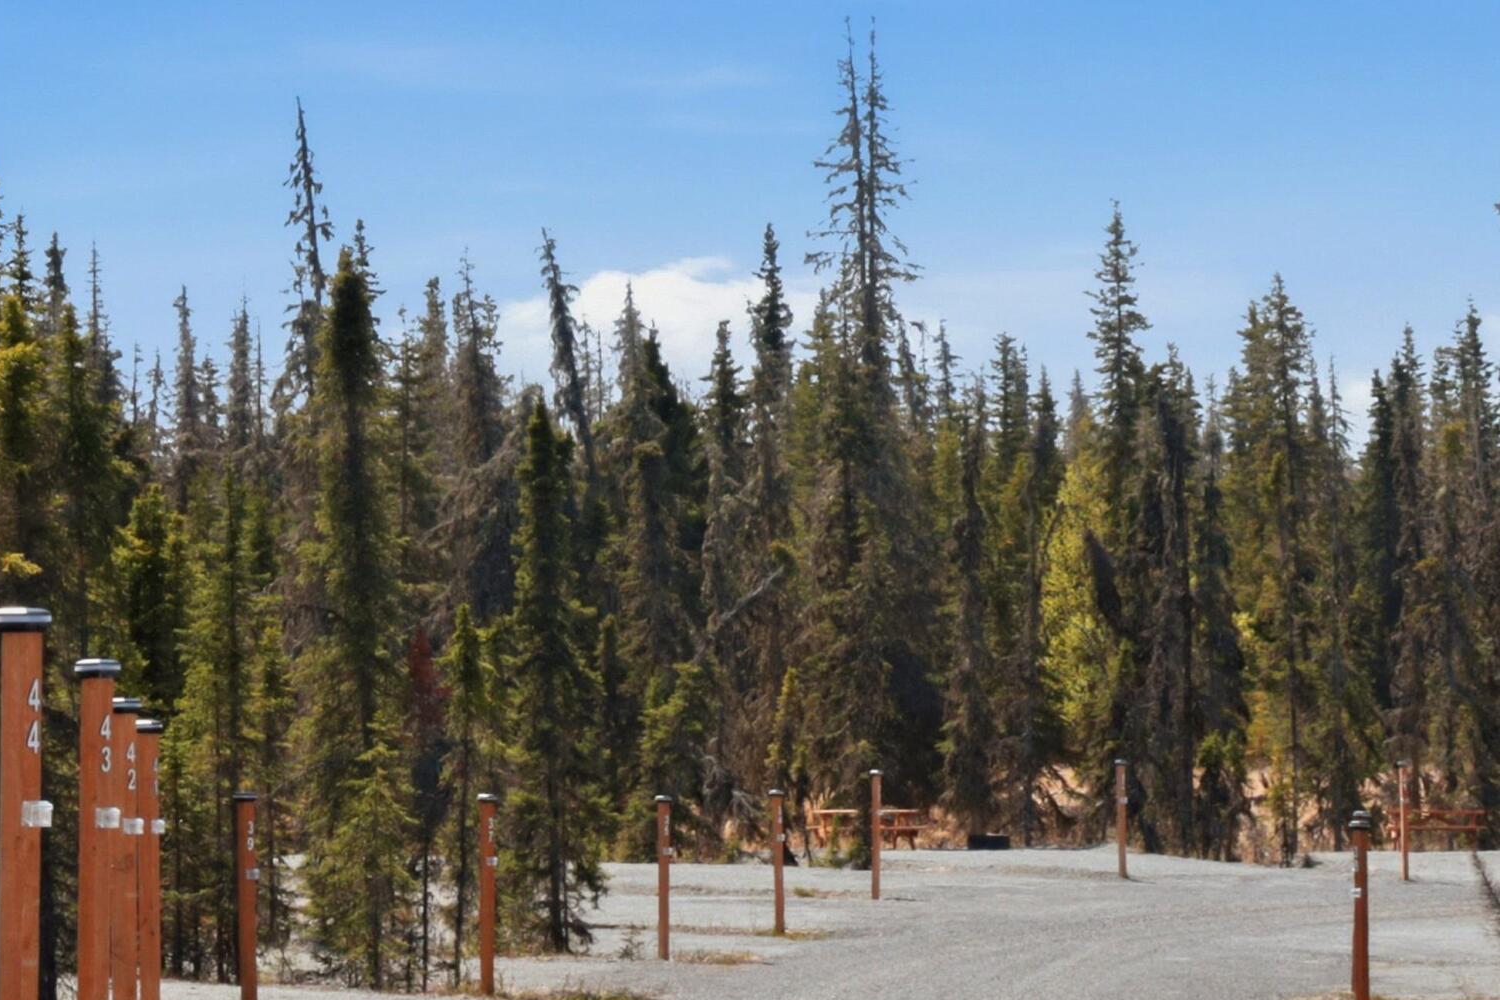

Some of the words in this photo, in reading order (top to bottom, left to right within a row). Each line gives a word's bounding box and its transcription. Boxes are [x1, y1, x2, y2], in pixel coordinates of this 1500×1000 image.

[27, 678, 41, 754] 44
[100, 714, 112, 773] 43
[126, 741, 137, 790] 42
